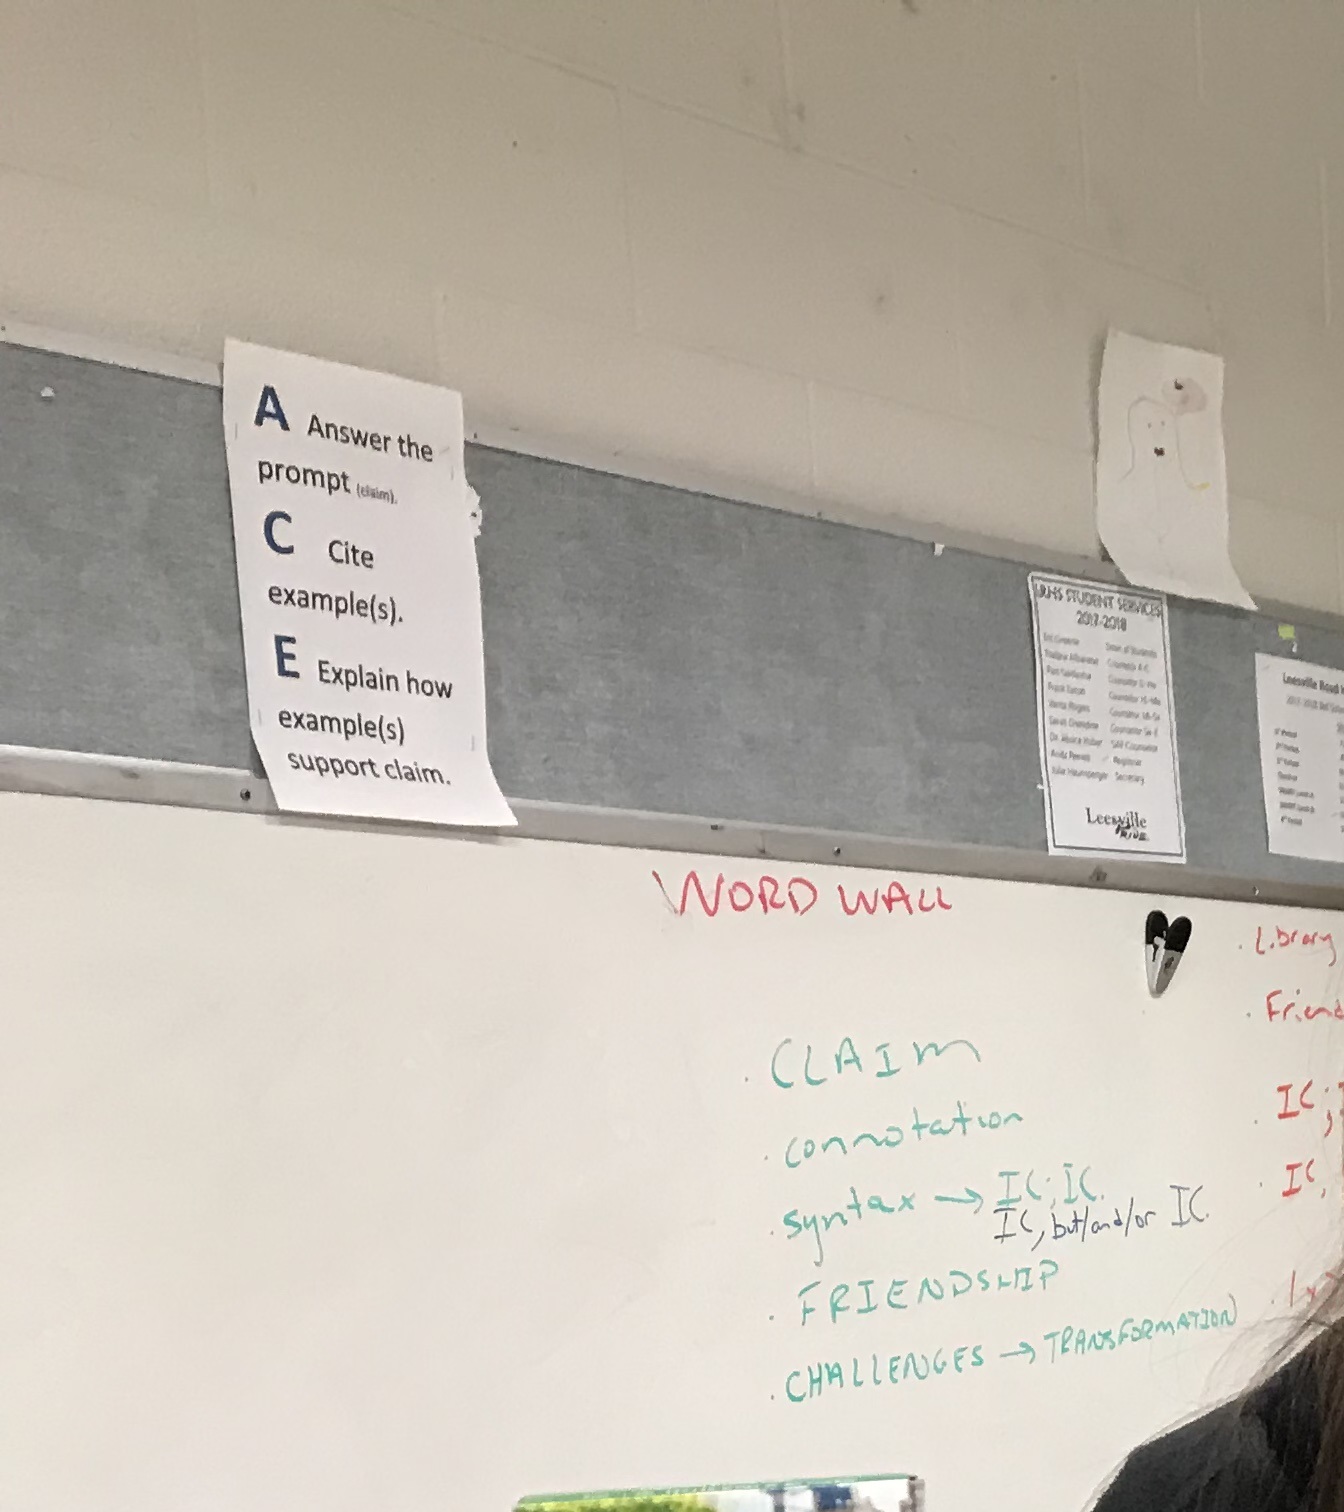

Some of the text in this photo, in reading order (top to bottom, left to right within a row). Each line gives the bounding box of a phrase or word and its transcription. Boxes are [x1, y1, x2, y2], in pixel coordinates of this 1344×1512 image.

[254, 385, 434, 462] A Answer the
[258, 459, 351, 496] prompt
[263, 511, 374, 569] C Cite
[268, 583, 404, 626] example(s).
[274, 635, 453, 700] E Explain how
[278, 706, 405, 745] example(s)
[287, 750, 452, 785] support claim.
[1085, 807, 1147, 828] Leesville
[652, 870, 953, 917] WORD WALL
[786, 1100, 1024, 1168] connotation
[783, 1186, 916, 1267] syntax
[798, 1259, 1059, 1326] FRIENDSHIP
[786, 1344, 984, 1403] CHALLENGES
